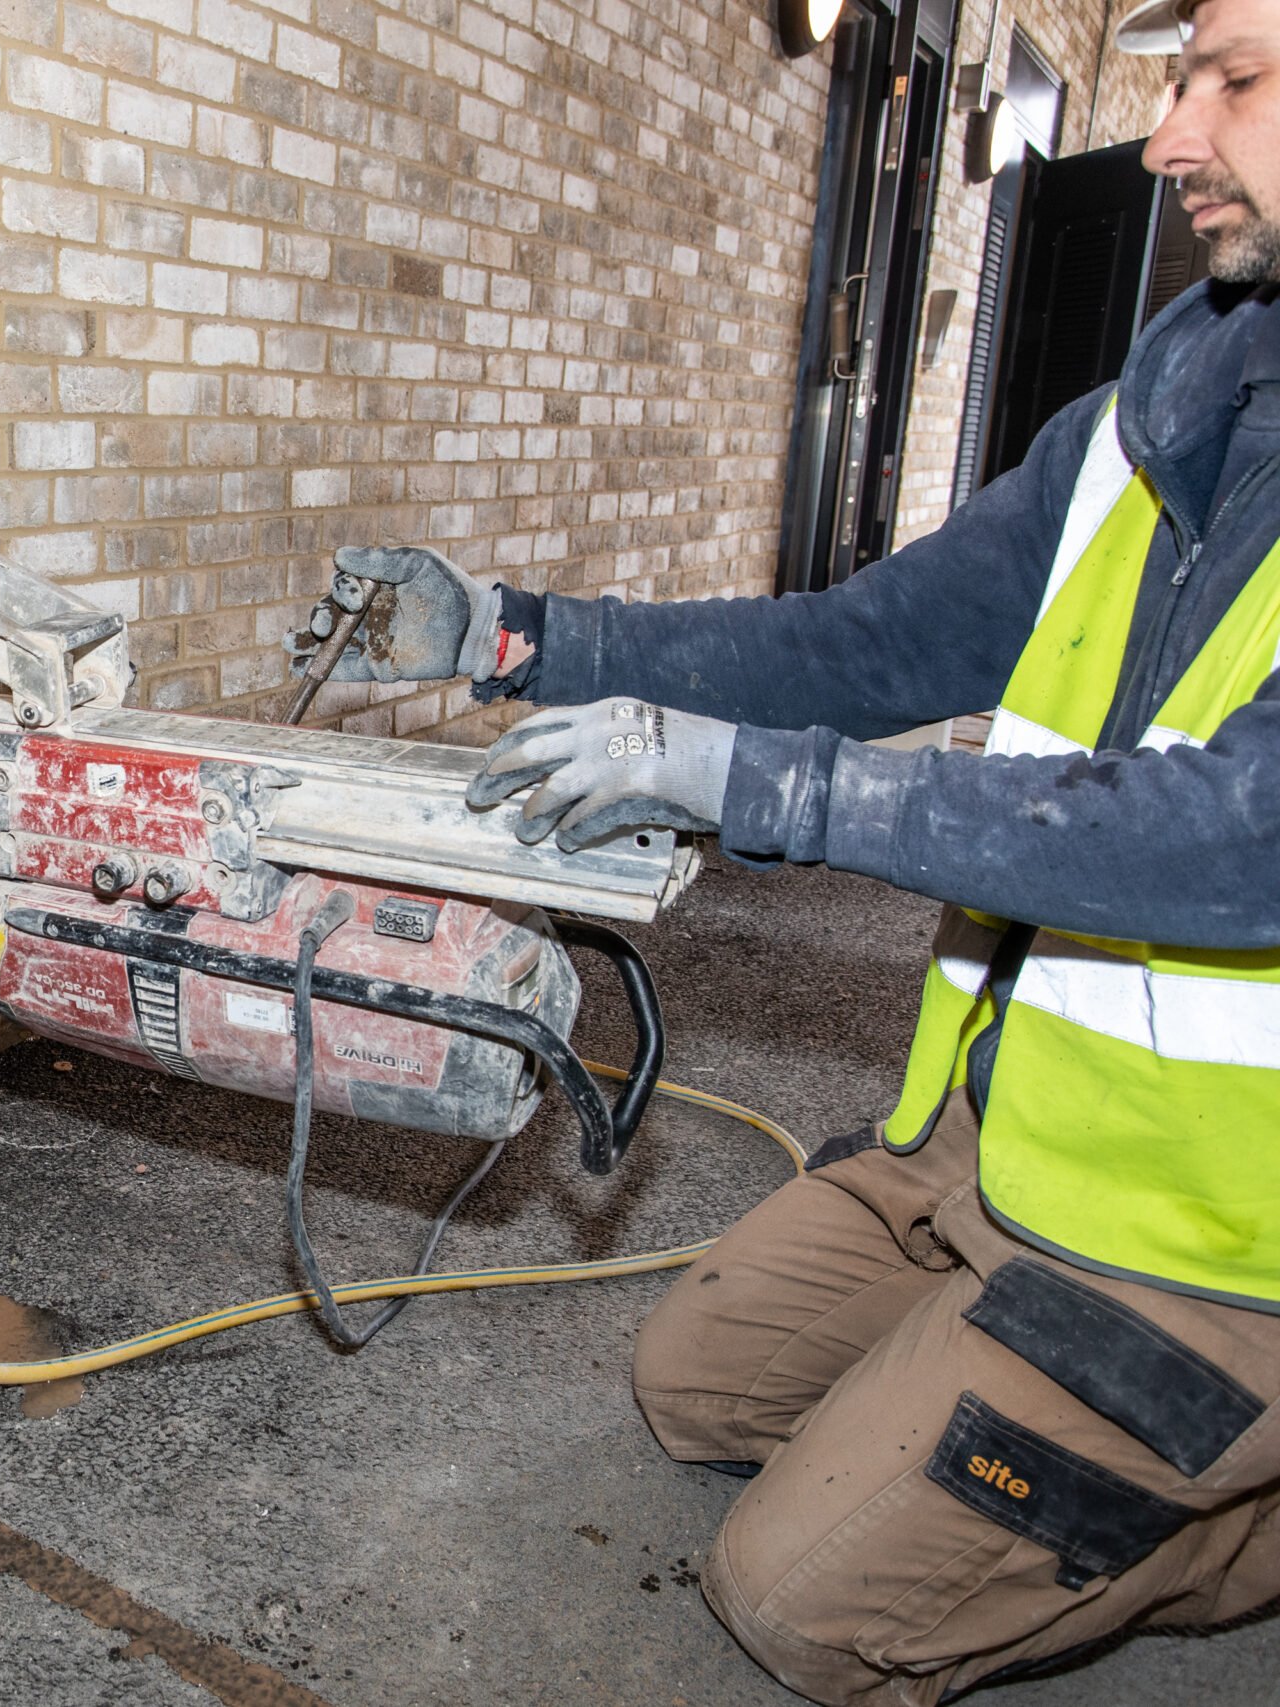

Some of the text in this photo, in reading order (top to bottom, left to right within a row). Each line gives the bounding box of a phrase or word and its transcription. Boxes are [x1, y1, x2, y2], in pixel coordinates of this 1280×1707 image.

[35, 984, 115, 1017] HILTI
[85, 986, 106, 999] DD
[967, 1453, 1030, 1500] site
